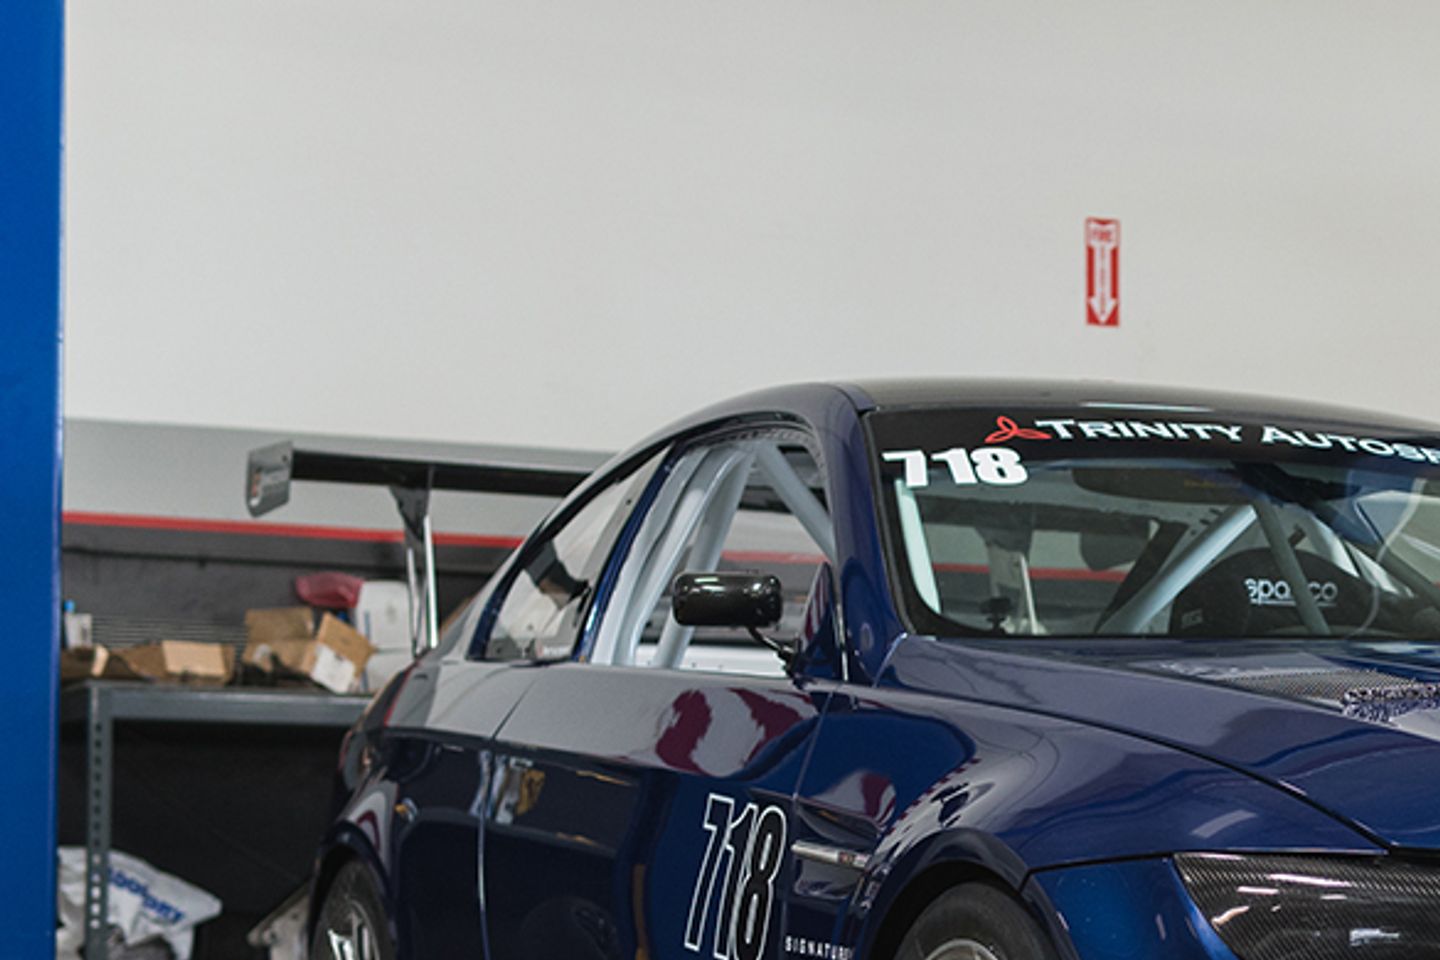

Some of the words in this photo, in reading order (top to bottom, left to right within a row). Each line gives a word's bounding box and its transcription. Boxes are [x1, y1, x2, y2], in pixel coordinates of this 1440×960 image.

[1034, 418, 1243, 442] TRINITY
[881, 447, 1028, 488] 718
[1244, 578, 1338, 606] spaco
